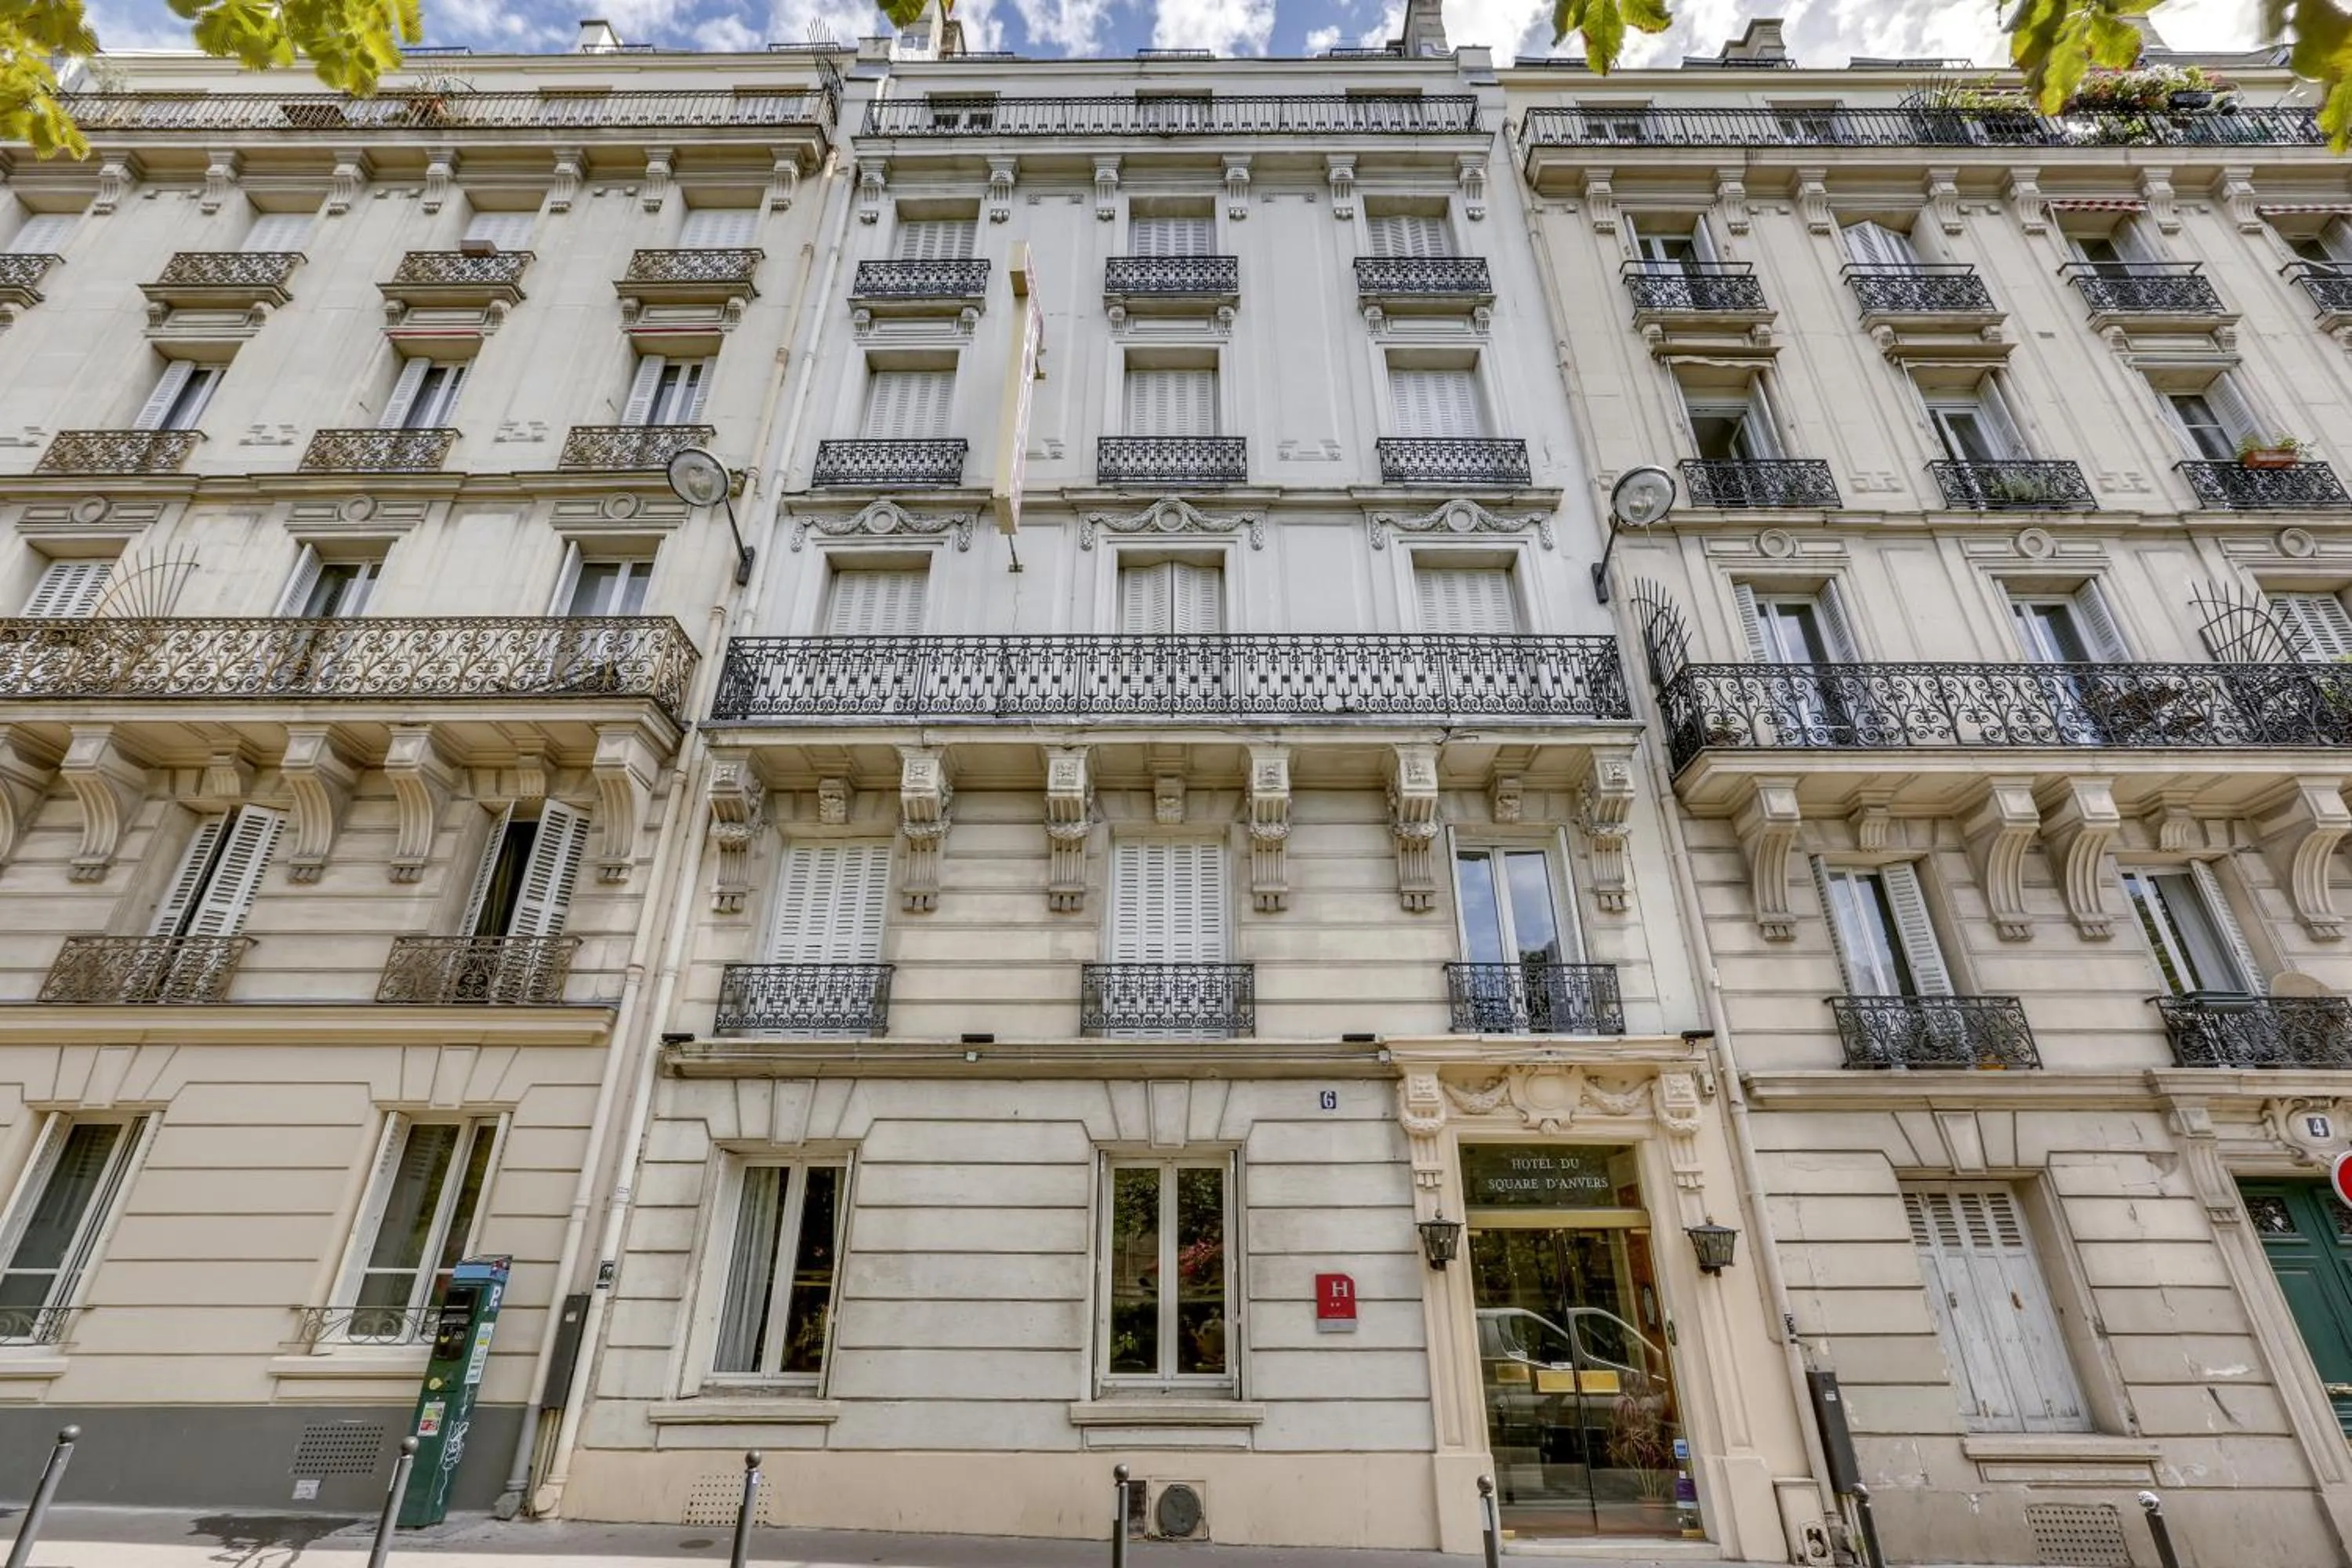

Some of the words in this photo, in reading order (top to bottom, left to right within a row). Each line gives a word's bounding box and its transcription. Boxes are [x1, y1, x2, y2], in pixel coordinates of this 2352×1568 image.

[1323, 1091, 1334, 1108] 6
[2313, 1119, 2325, 1137] 4
[1560, 1158, 1580, 1169] DU
[1488, 1178, 1539, 1192] SQUARE
[1546, 1177, 1609, 1189] D'ANVERS
[1331, 1280, 1348, 1298] H
